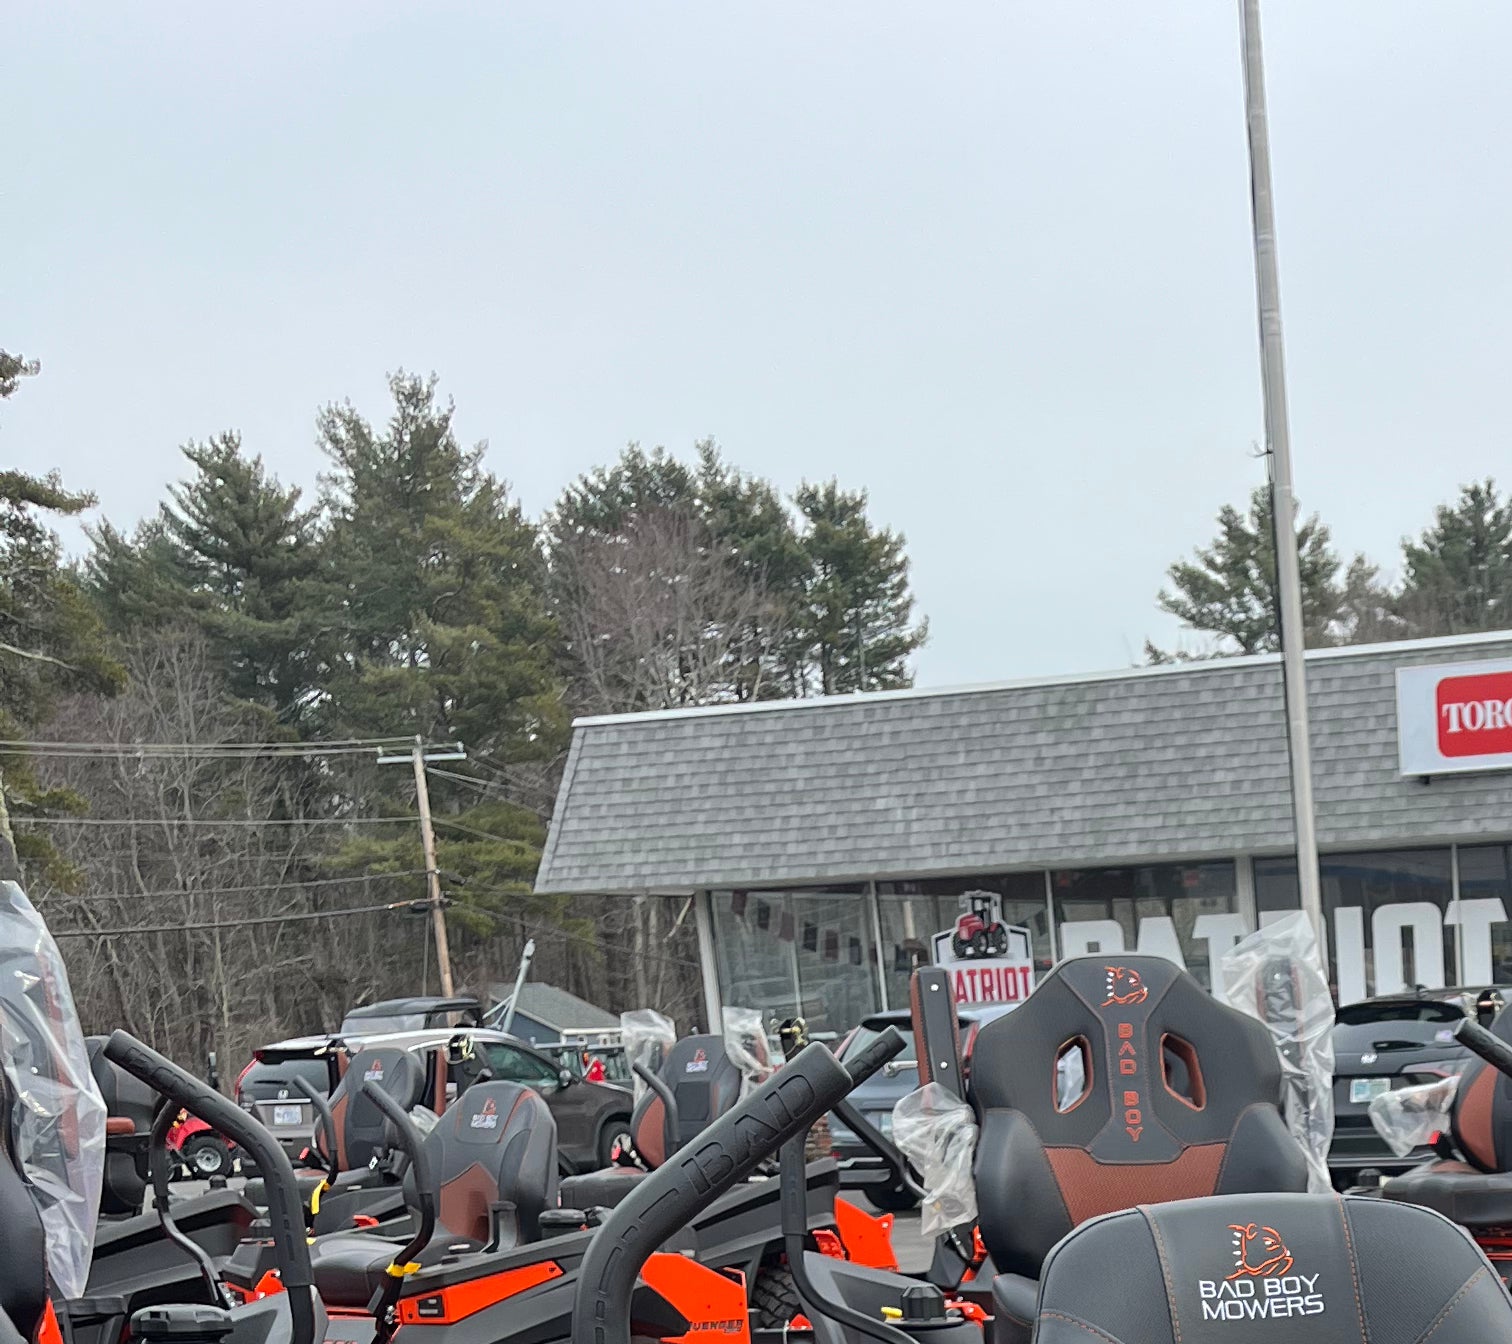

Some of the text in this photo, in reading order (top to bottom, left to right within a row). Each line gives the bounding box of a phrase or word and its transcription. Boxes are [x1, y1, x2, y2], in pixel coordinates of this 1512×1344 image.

[1060, 897, 1508, 1008] TIOT
[950, 966, 1030, 1003] ATRIOT
[1199, 1273, 1320, 1299] BAD BOY
[1201, 1294, 1325, 1320] MOWERS
